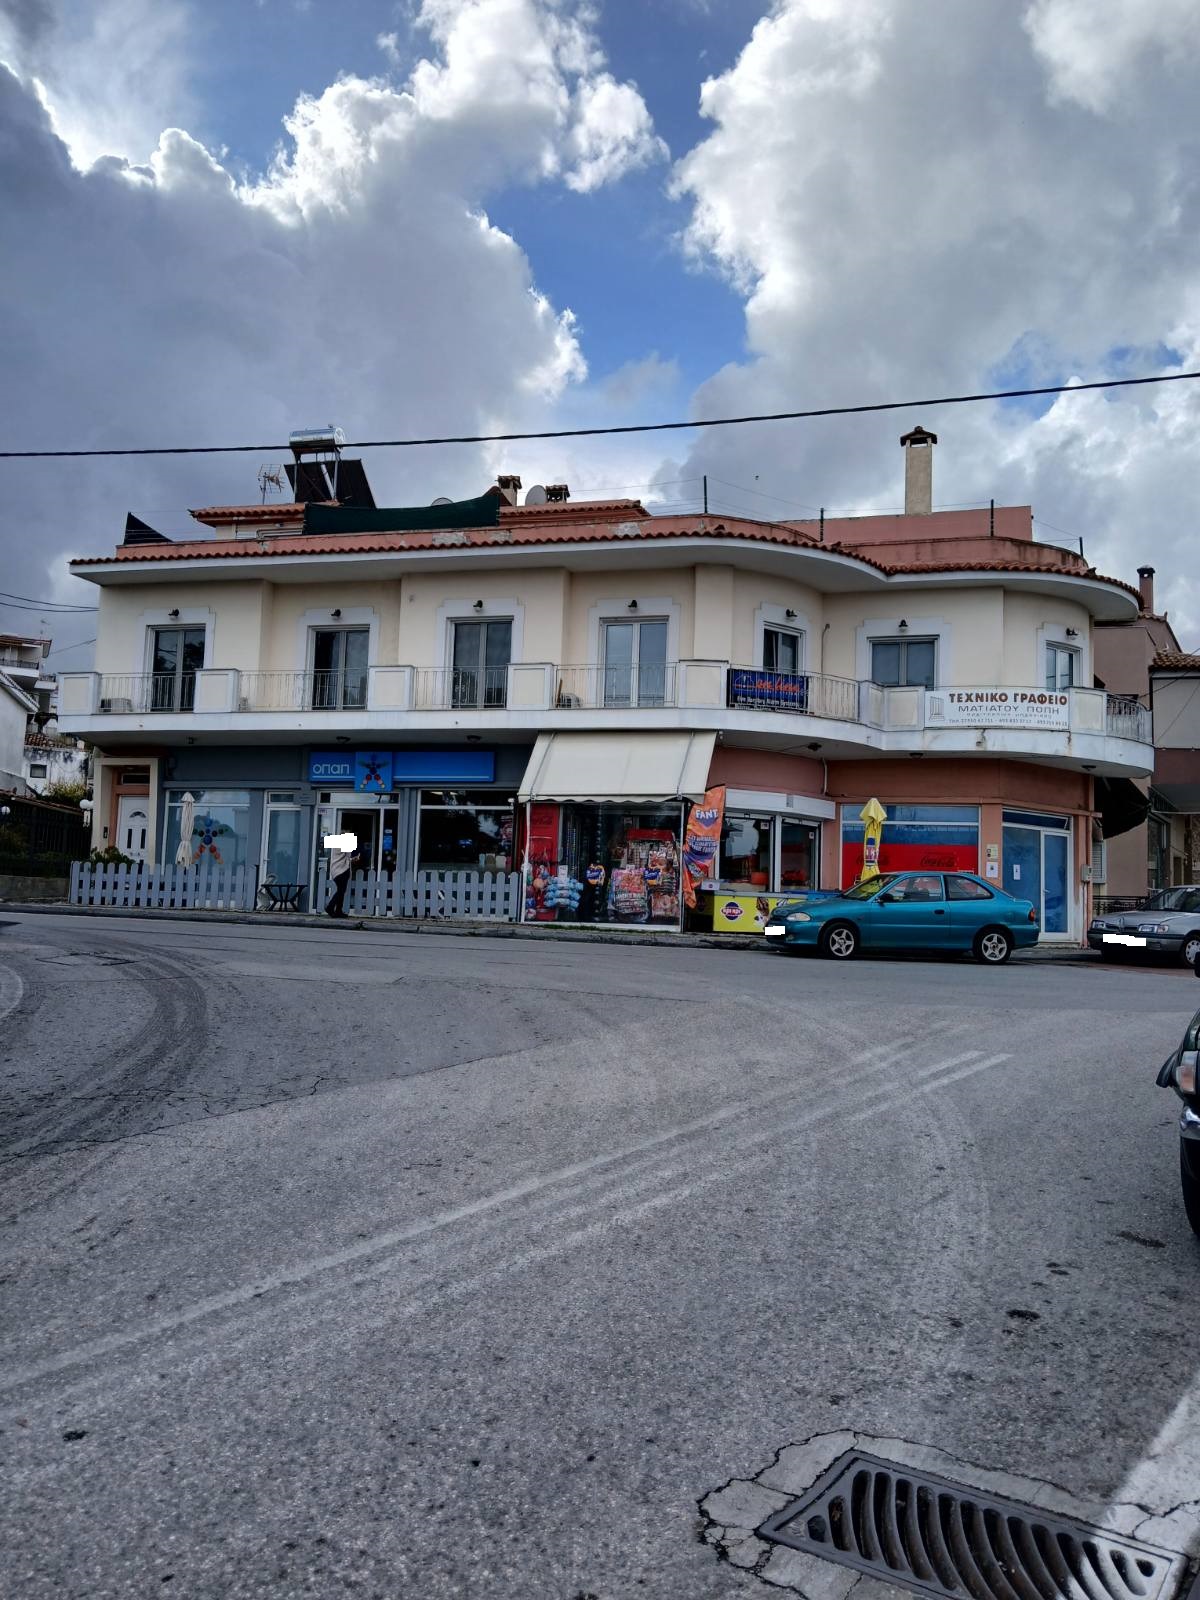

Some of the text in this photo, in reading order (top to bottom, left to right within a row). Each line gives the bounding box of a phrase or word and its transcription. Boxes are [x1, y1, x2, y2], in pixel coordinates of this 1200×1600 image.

[949, 692, 1068, 706] ΤΕΧΝΙΚΟ ΓΡΑΦΕΙΟ
[958, 705, 1060, 715] ΜΑΤΙΑΤΟΥ ΠΟΠΗ
[695, 808, 719, 820] FANT
